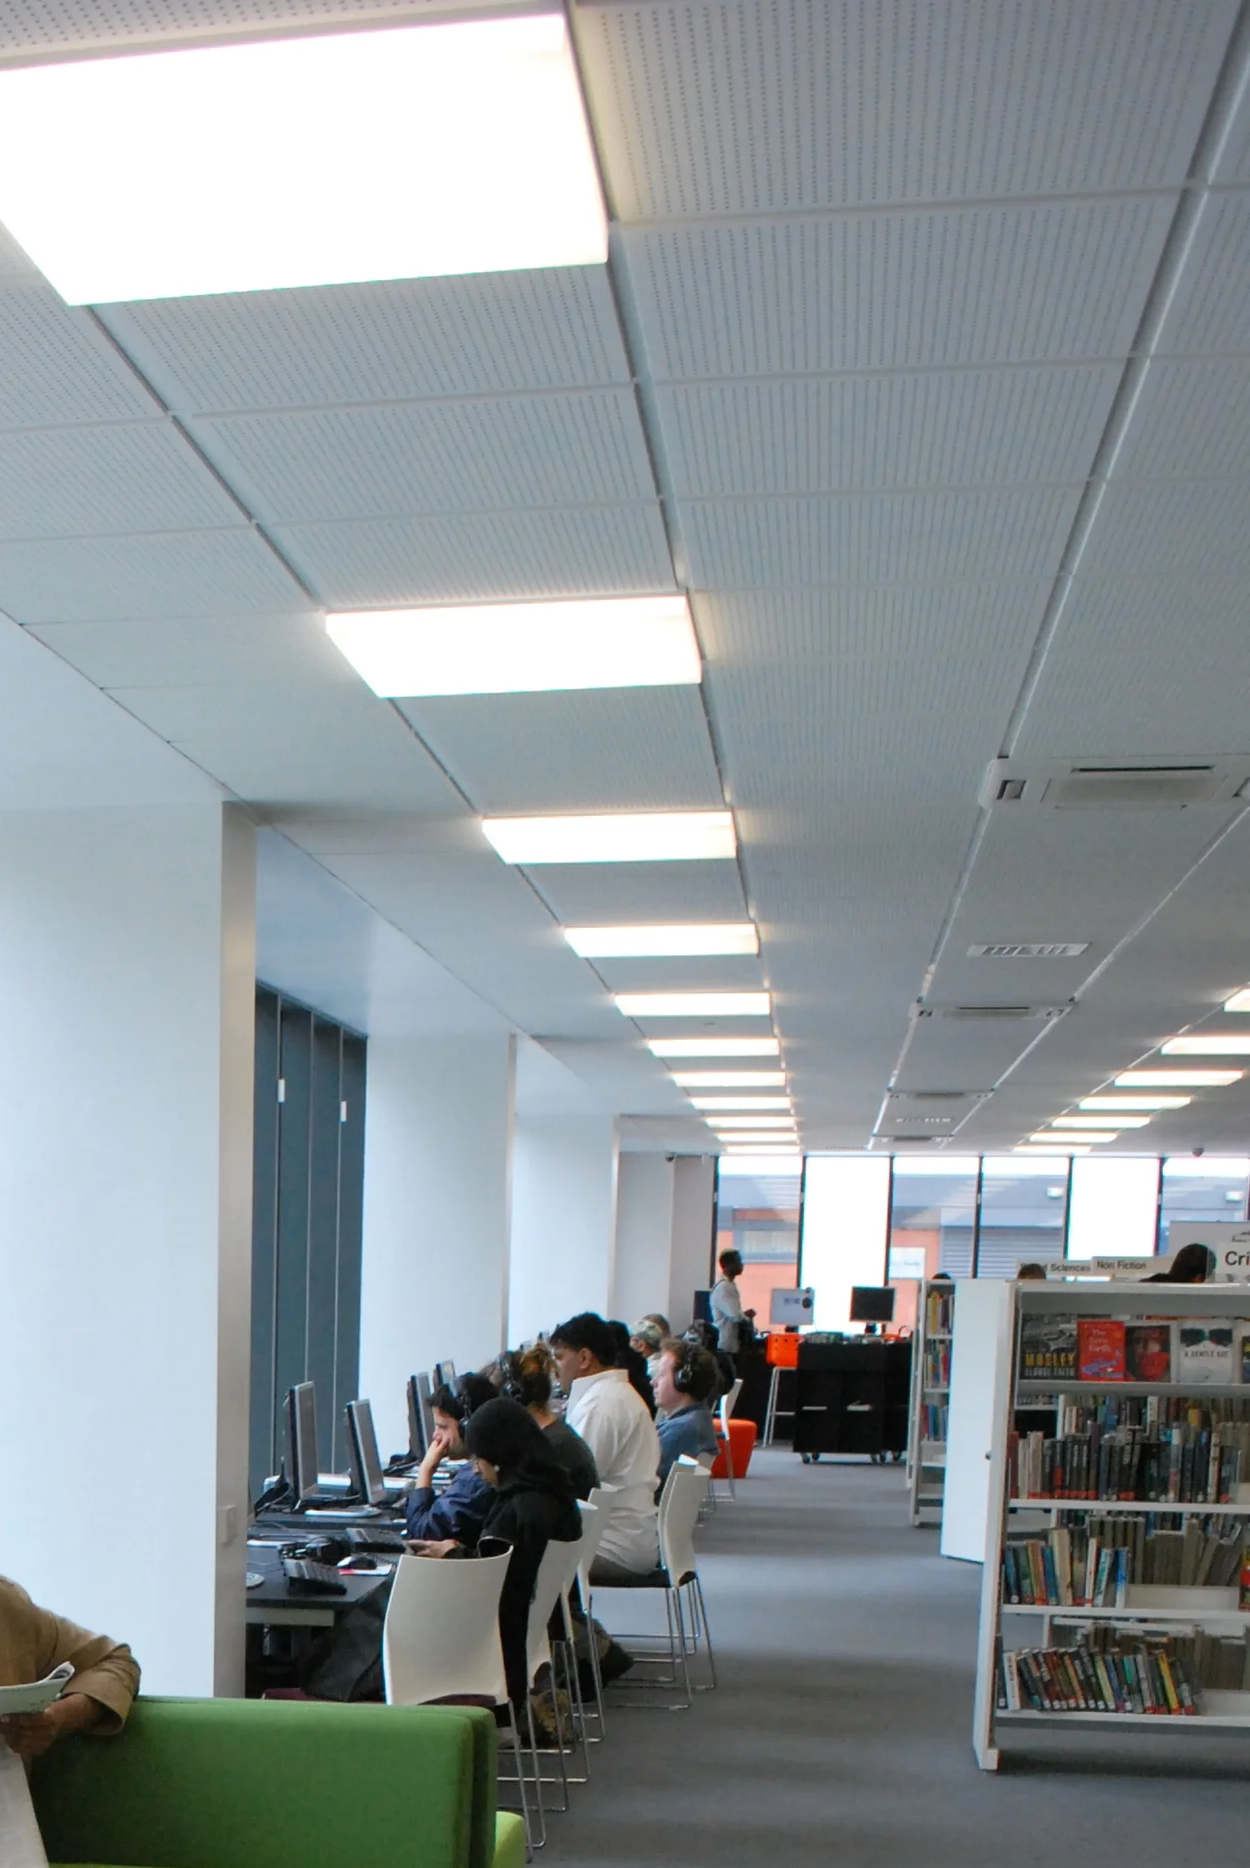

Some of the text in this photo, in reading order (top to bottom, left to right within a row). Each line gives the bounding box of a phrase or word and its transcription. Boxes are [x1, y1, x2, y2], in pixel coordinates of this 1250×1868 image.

[1050, 1263, 1091, 1273] Sciences
[1097, 1260, 1147, 1271] Non Fiction
[1025, 1352, 1077, 1368] MOSLEY
